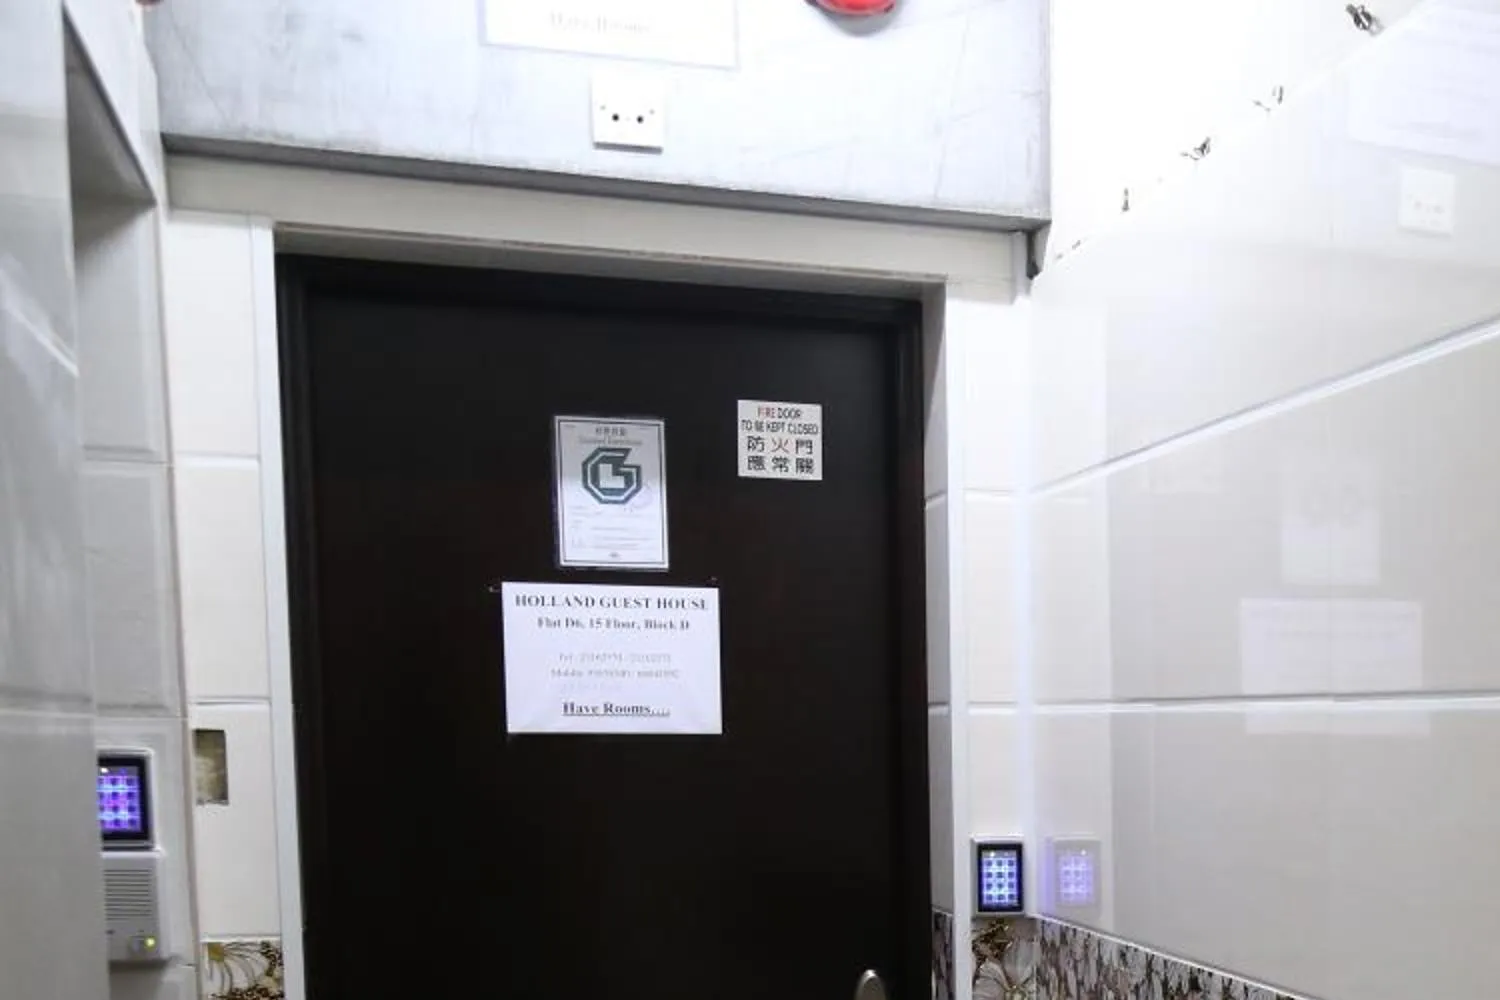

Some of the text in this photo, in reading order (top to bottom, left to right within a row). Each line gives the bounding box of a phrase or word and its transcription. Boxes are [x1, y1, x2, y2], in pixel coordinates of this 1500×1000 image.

[758, 407, 802, 419] FIRE DOOR
[741, 419, 752, 431] TO
[766, 421, 785, 433] KEPT
[787, 423, 819, 435] CLOSED
[747, 435, 813, 455] 防火門
[515, 594, 709, 610] HOLLAND GUEST HOUSE
[537, 617, 561, 629] Flat
[589, 617, 602, 629] 15
[605, 618, 641, 631] Floor,
[644, 619, 677, 630] Block
[562, 701, 599, 717] Have
